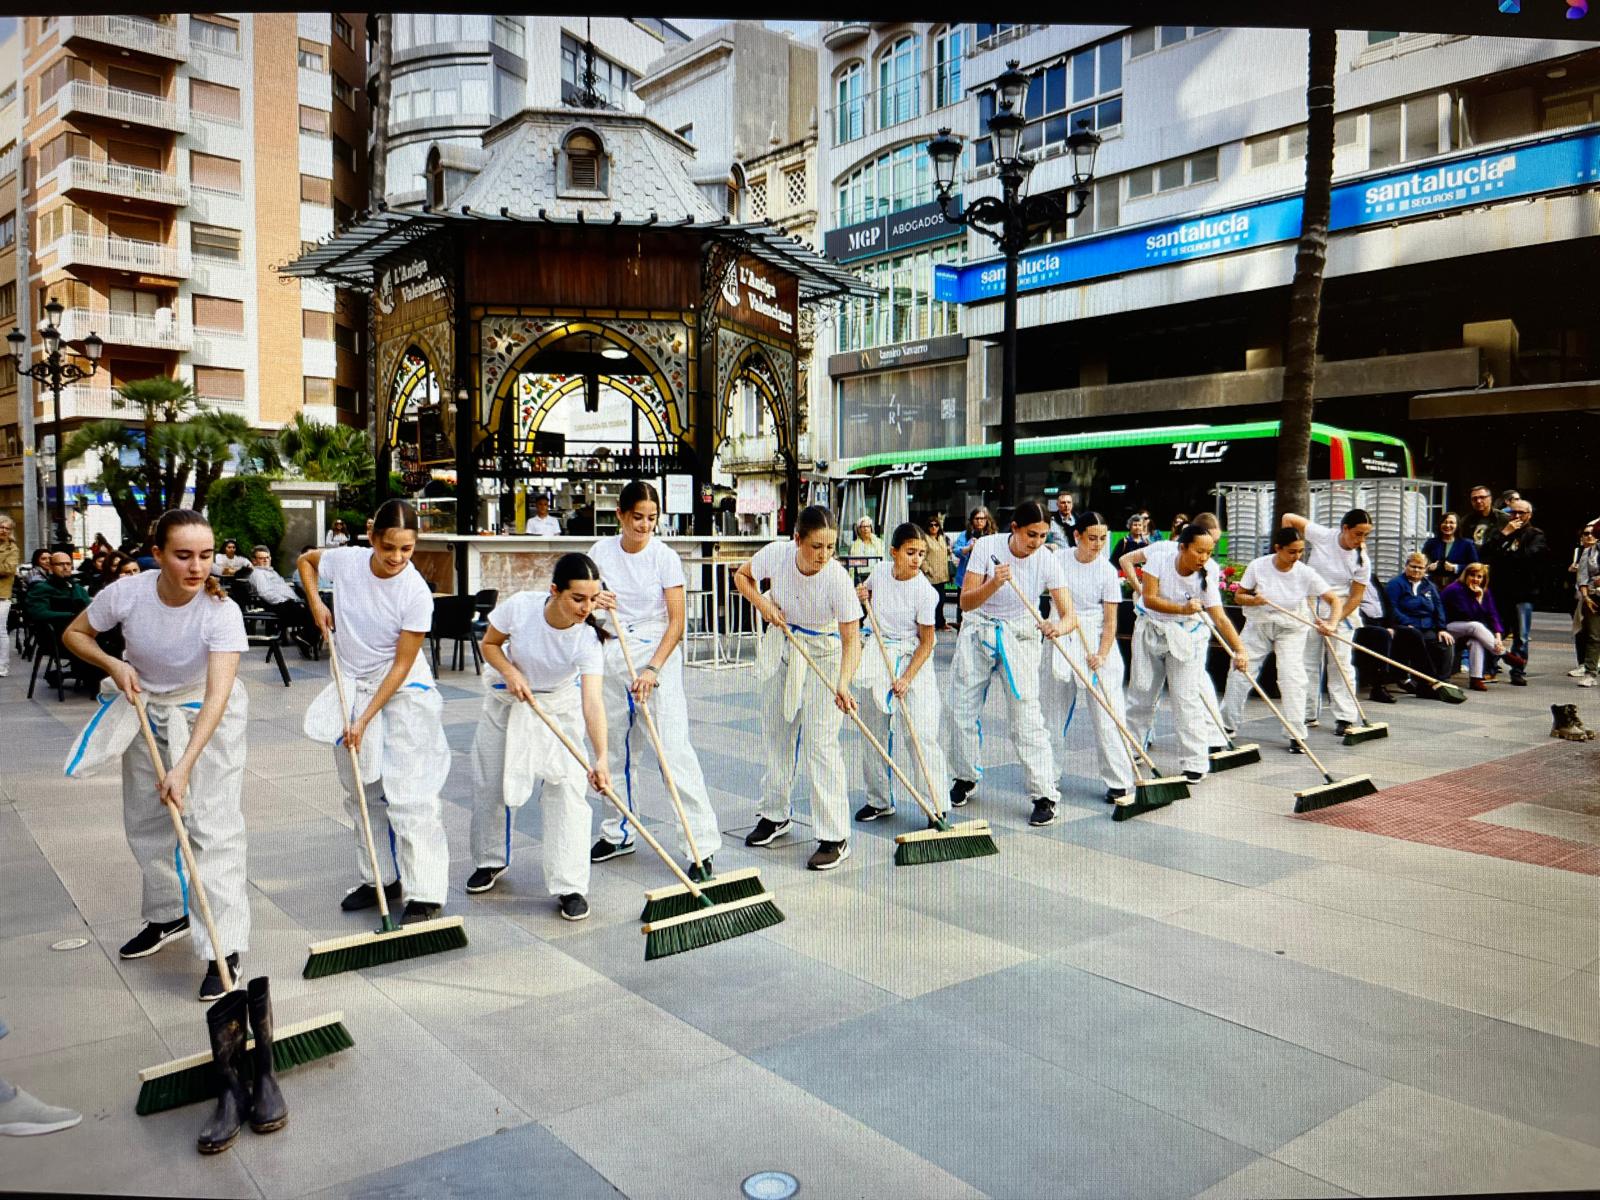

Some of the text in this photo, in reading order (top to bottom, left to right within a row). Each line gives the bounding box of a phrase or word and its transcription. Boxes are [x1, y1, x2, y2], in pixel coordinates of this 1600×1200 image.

[1365, 159, 1504, 204] santalucía
[1411, 191, 1454, 209] SEGUROS
[848, 213, 944, 252] MGP ABOGADOS
[1145, 214, 1249, 250] santalucía
[981, 254, 1060, 285] sanlucía
